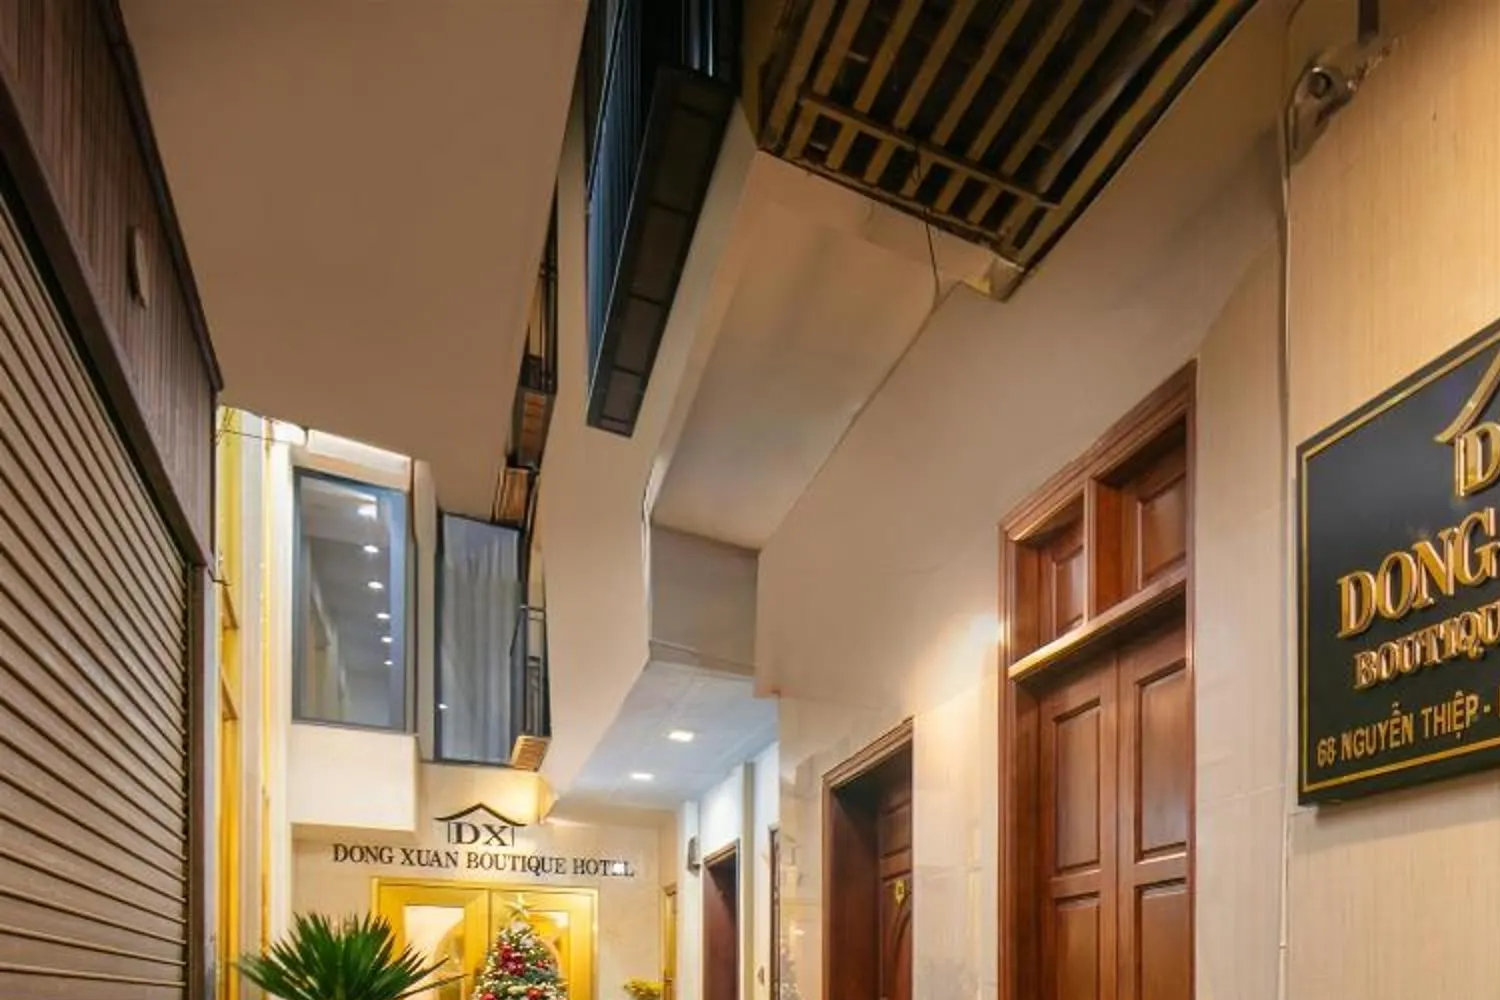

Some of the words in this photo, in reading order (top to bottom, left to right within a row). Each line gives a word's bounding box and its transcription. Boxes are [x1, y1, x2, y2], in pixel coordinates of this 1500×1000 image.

[1316, 736, 1336, 768] 68
[1341, 701, 1414, 761] NGUYỄN
[1420, 690, 1480, 739] THIỆP
[454, 822, 508, 847] DX
[332, 843, 394, 865] DONG
[400, 848, 459, 869] XUAN
[466, 853, 567, 877] BOUTIQUE
